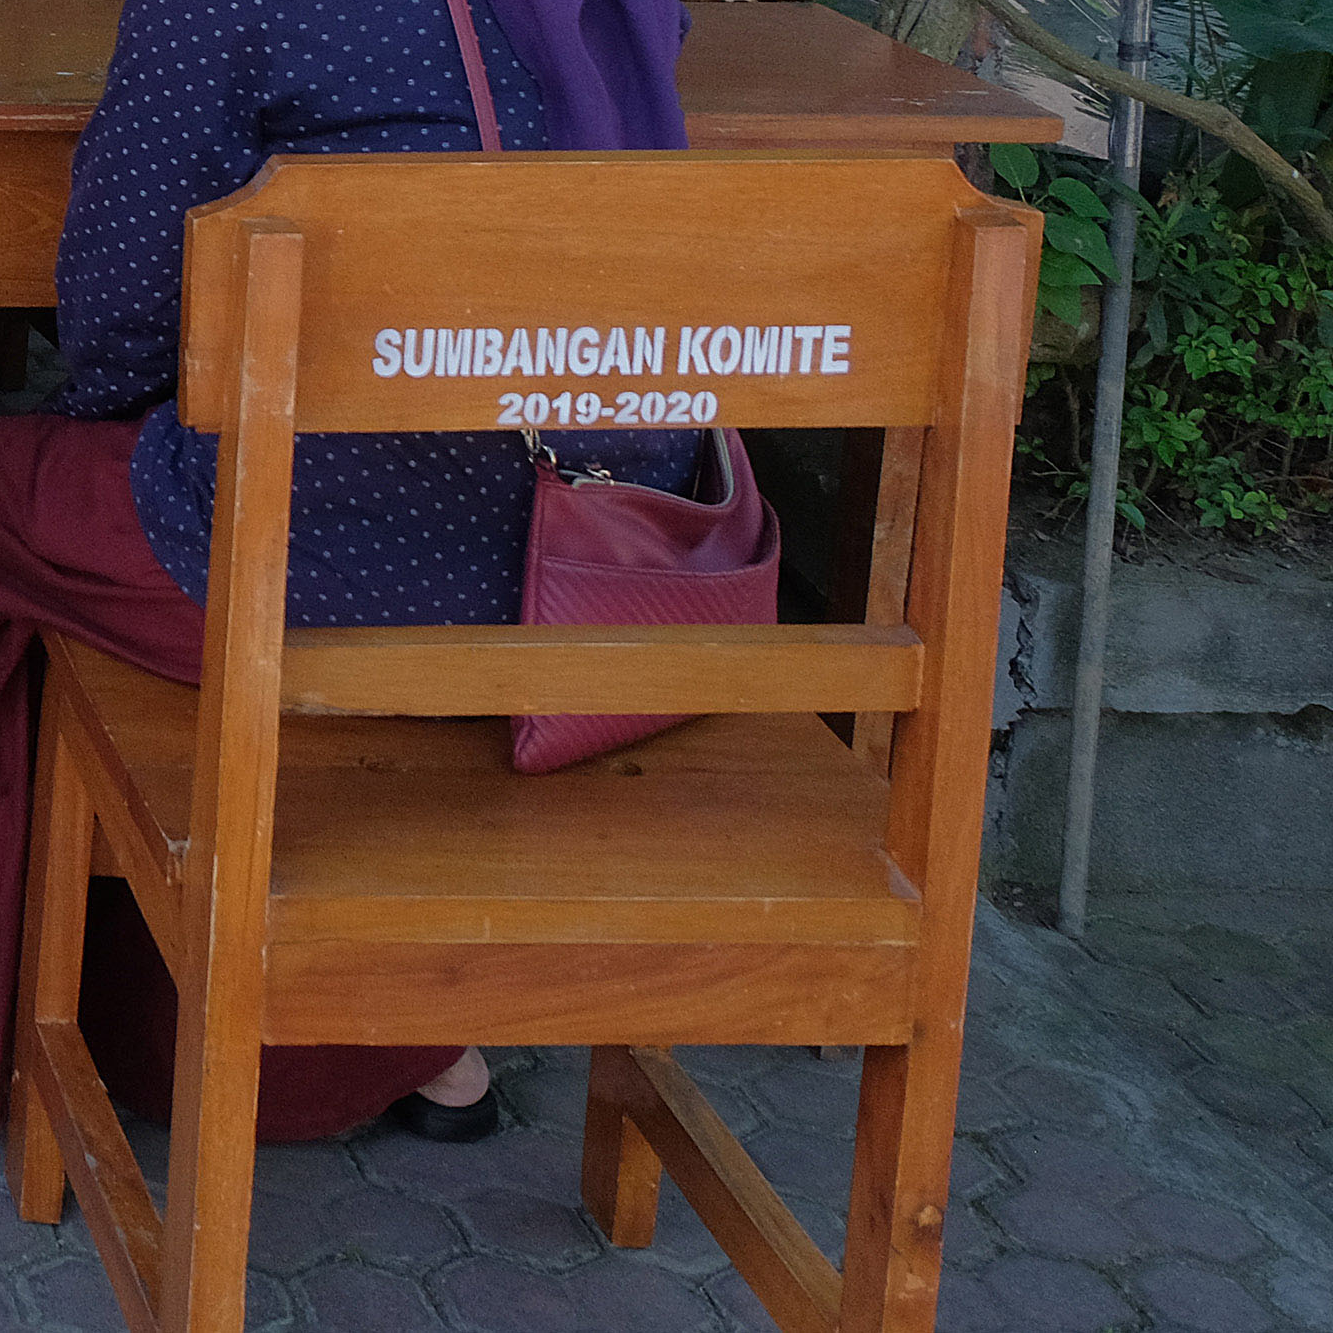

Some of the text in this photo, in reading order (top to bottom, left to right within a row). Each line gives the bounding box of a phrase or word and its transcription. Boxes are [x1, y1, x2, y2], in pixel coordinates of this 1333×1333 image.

[372, 325, 852, 378] SUMBANGAN KOMITE
[496, 391, 718, 425] 2019-2020
